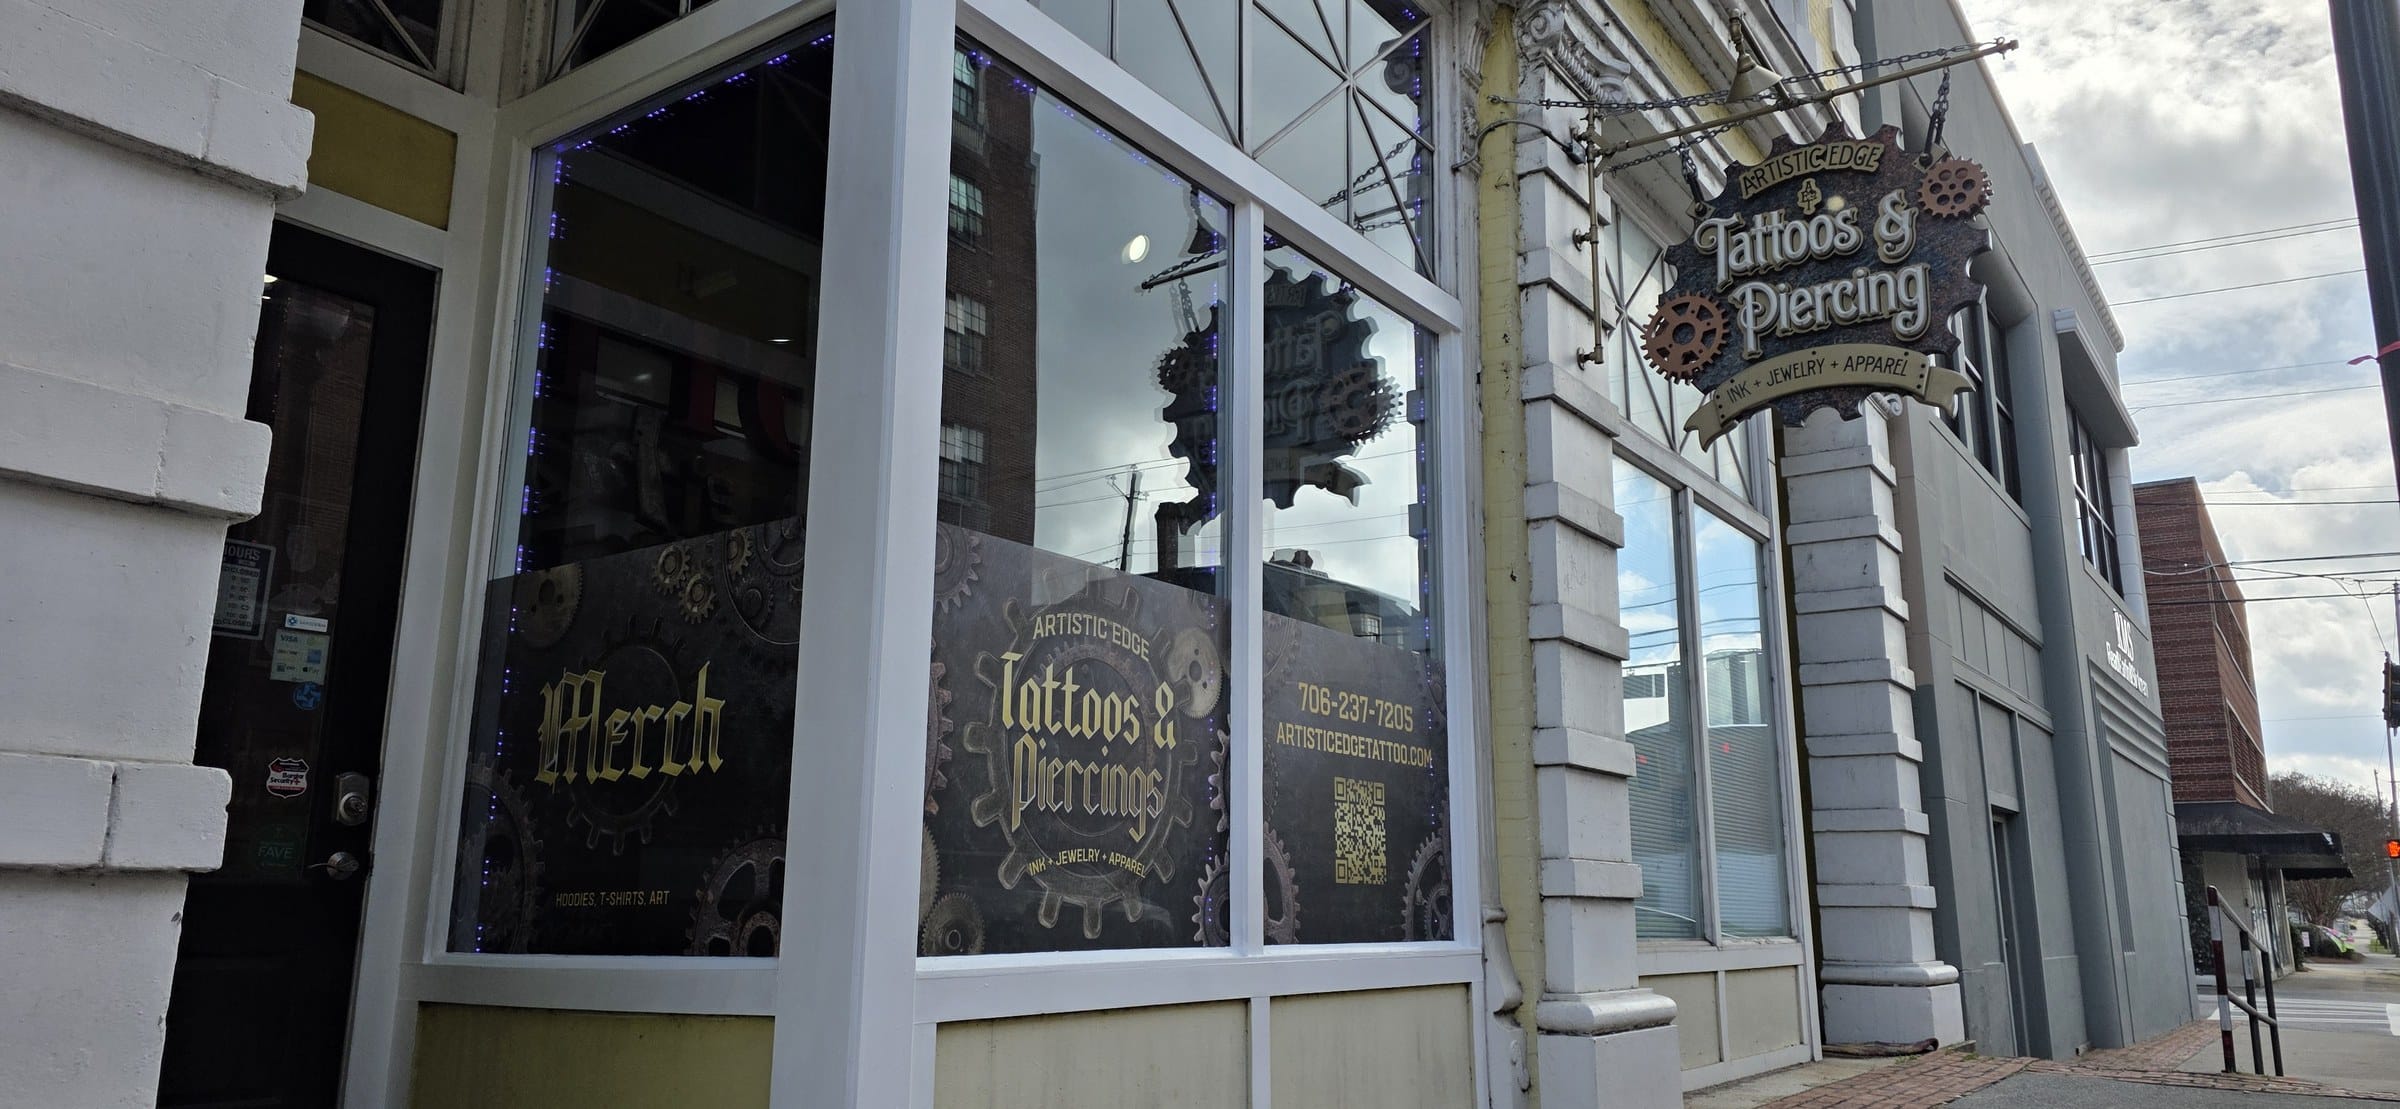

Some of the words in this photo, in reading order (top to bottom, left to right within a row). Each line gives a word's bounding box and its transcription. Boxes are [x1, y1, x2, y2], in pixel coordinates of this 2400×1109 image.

[1742, 147, 1822, 196] ARTISTIC
[1828, 145, 1881, 168] EDGE
[1695, 209, 1861, 291] Tattoos
[1876, 191, 1916, 261] &
[1730, 264, 1930, 358] Piercing
[1726, 381, 1752, 404] INK
[1767, 358, 1826, 387] JEWELRY
[1843, 355, 1909, 377] APPAREL
[280, 633, 298, 642] VISA
[1032, 612, 1108, 640] ARTISTIC
[1111, 622, 1150, 662] EDGE
[1000, 651, 1141, 745] Tattoos
[1153, 681, 1177, 750] &
[1298, 682, 1414, 733] 706-237-7205
[534, 660, 726, 794] Merch
[1276, 721, 1433, 768] ARTISTICEDGETATTOO.COM
[1011, 732, 1168, 842] Piercings
[256, 846, 297, 860] FAVE
[1028, 857, 1047, 877] INK
[1055, 848, 1101, 866] JEWELRY
[1108, 851, 1147, 879] APPAREL
[649, 889, 671, 905] ART
